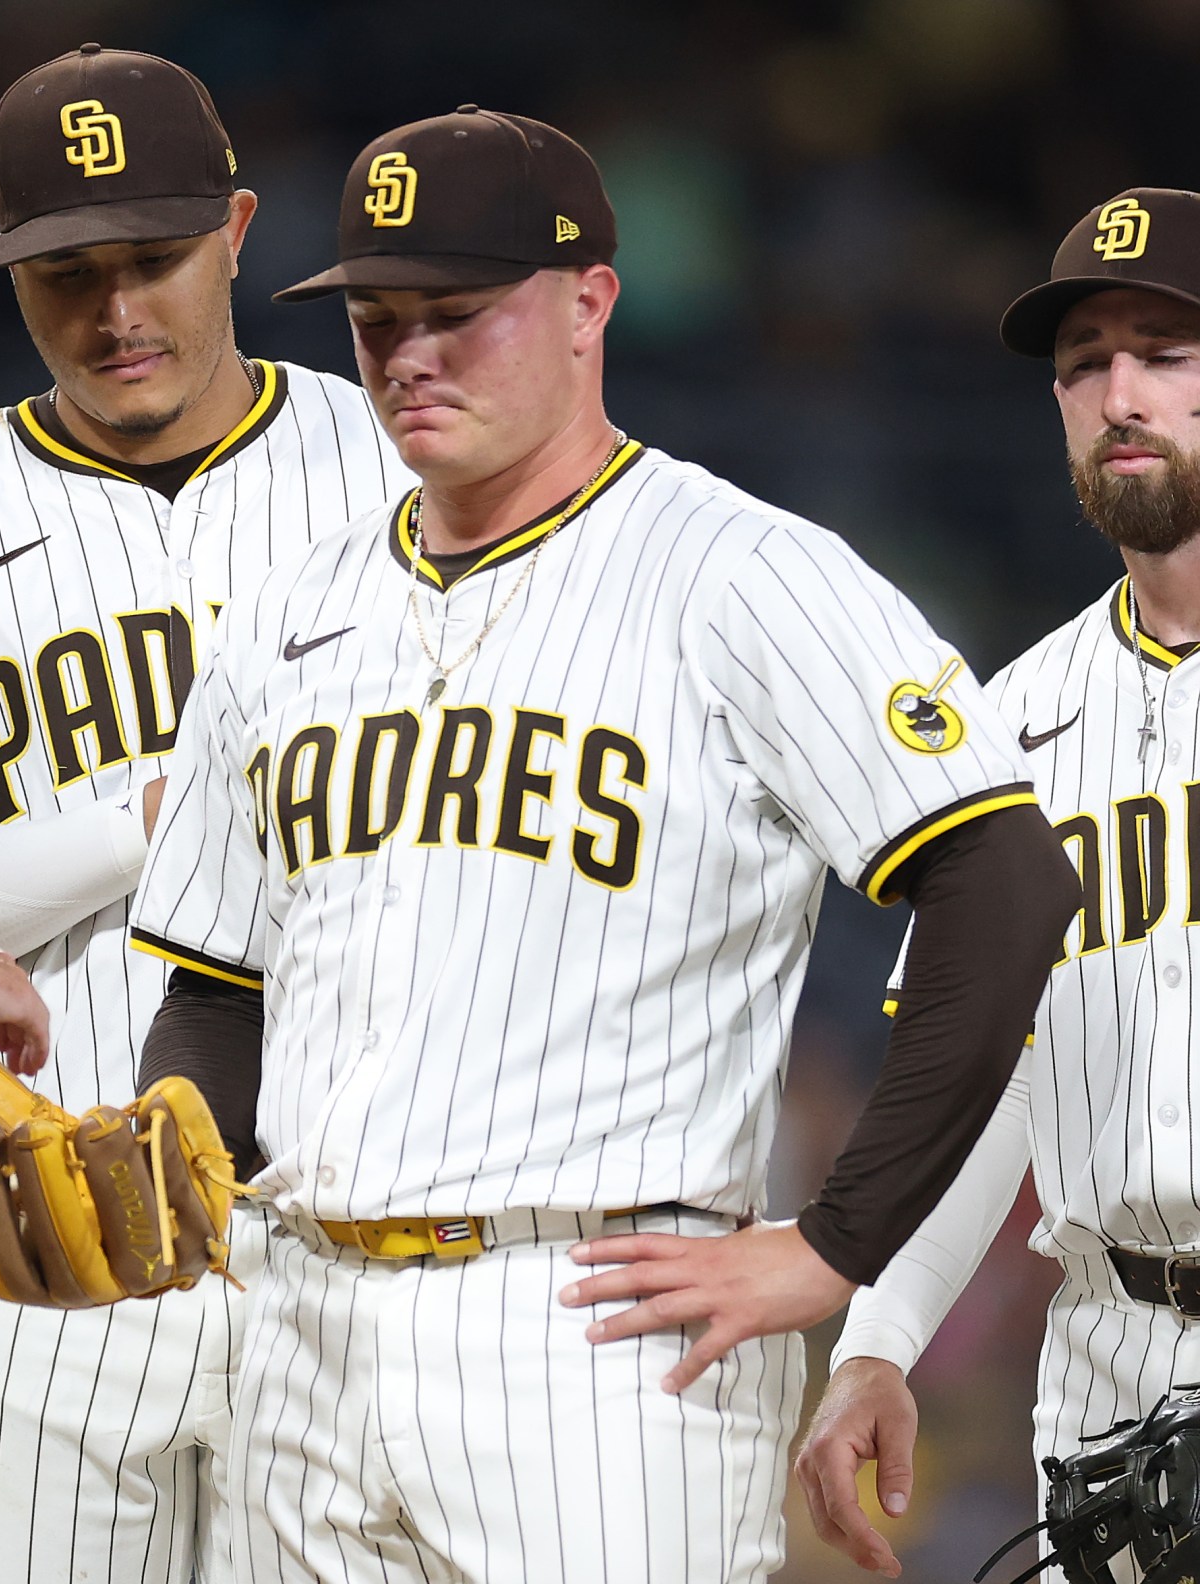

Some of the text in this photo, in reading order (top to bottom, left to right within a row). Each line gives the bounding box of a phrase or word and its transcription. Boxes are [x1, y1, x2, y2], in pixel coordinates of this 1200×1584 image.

[60, 99, 127, 178] SD
[364, 151, 418, 228] SD
[1093, 198, 1150, 261] SD
